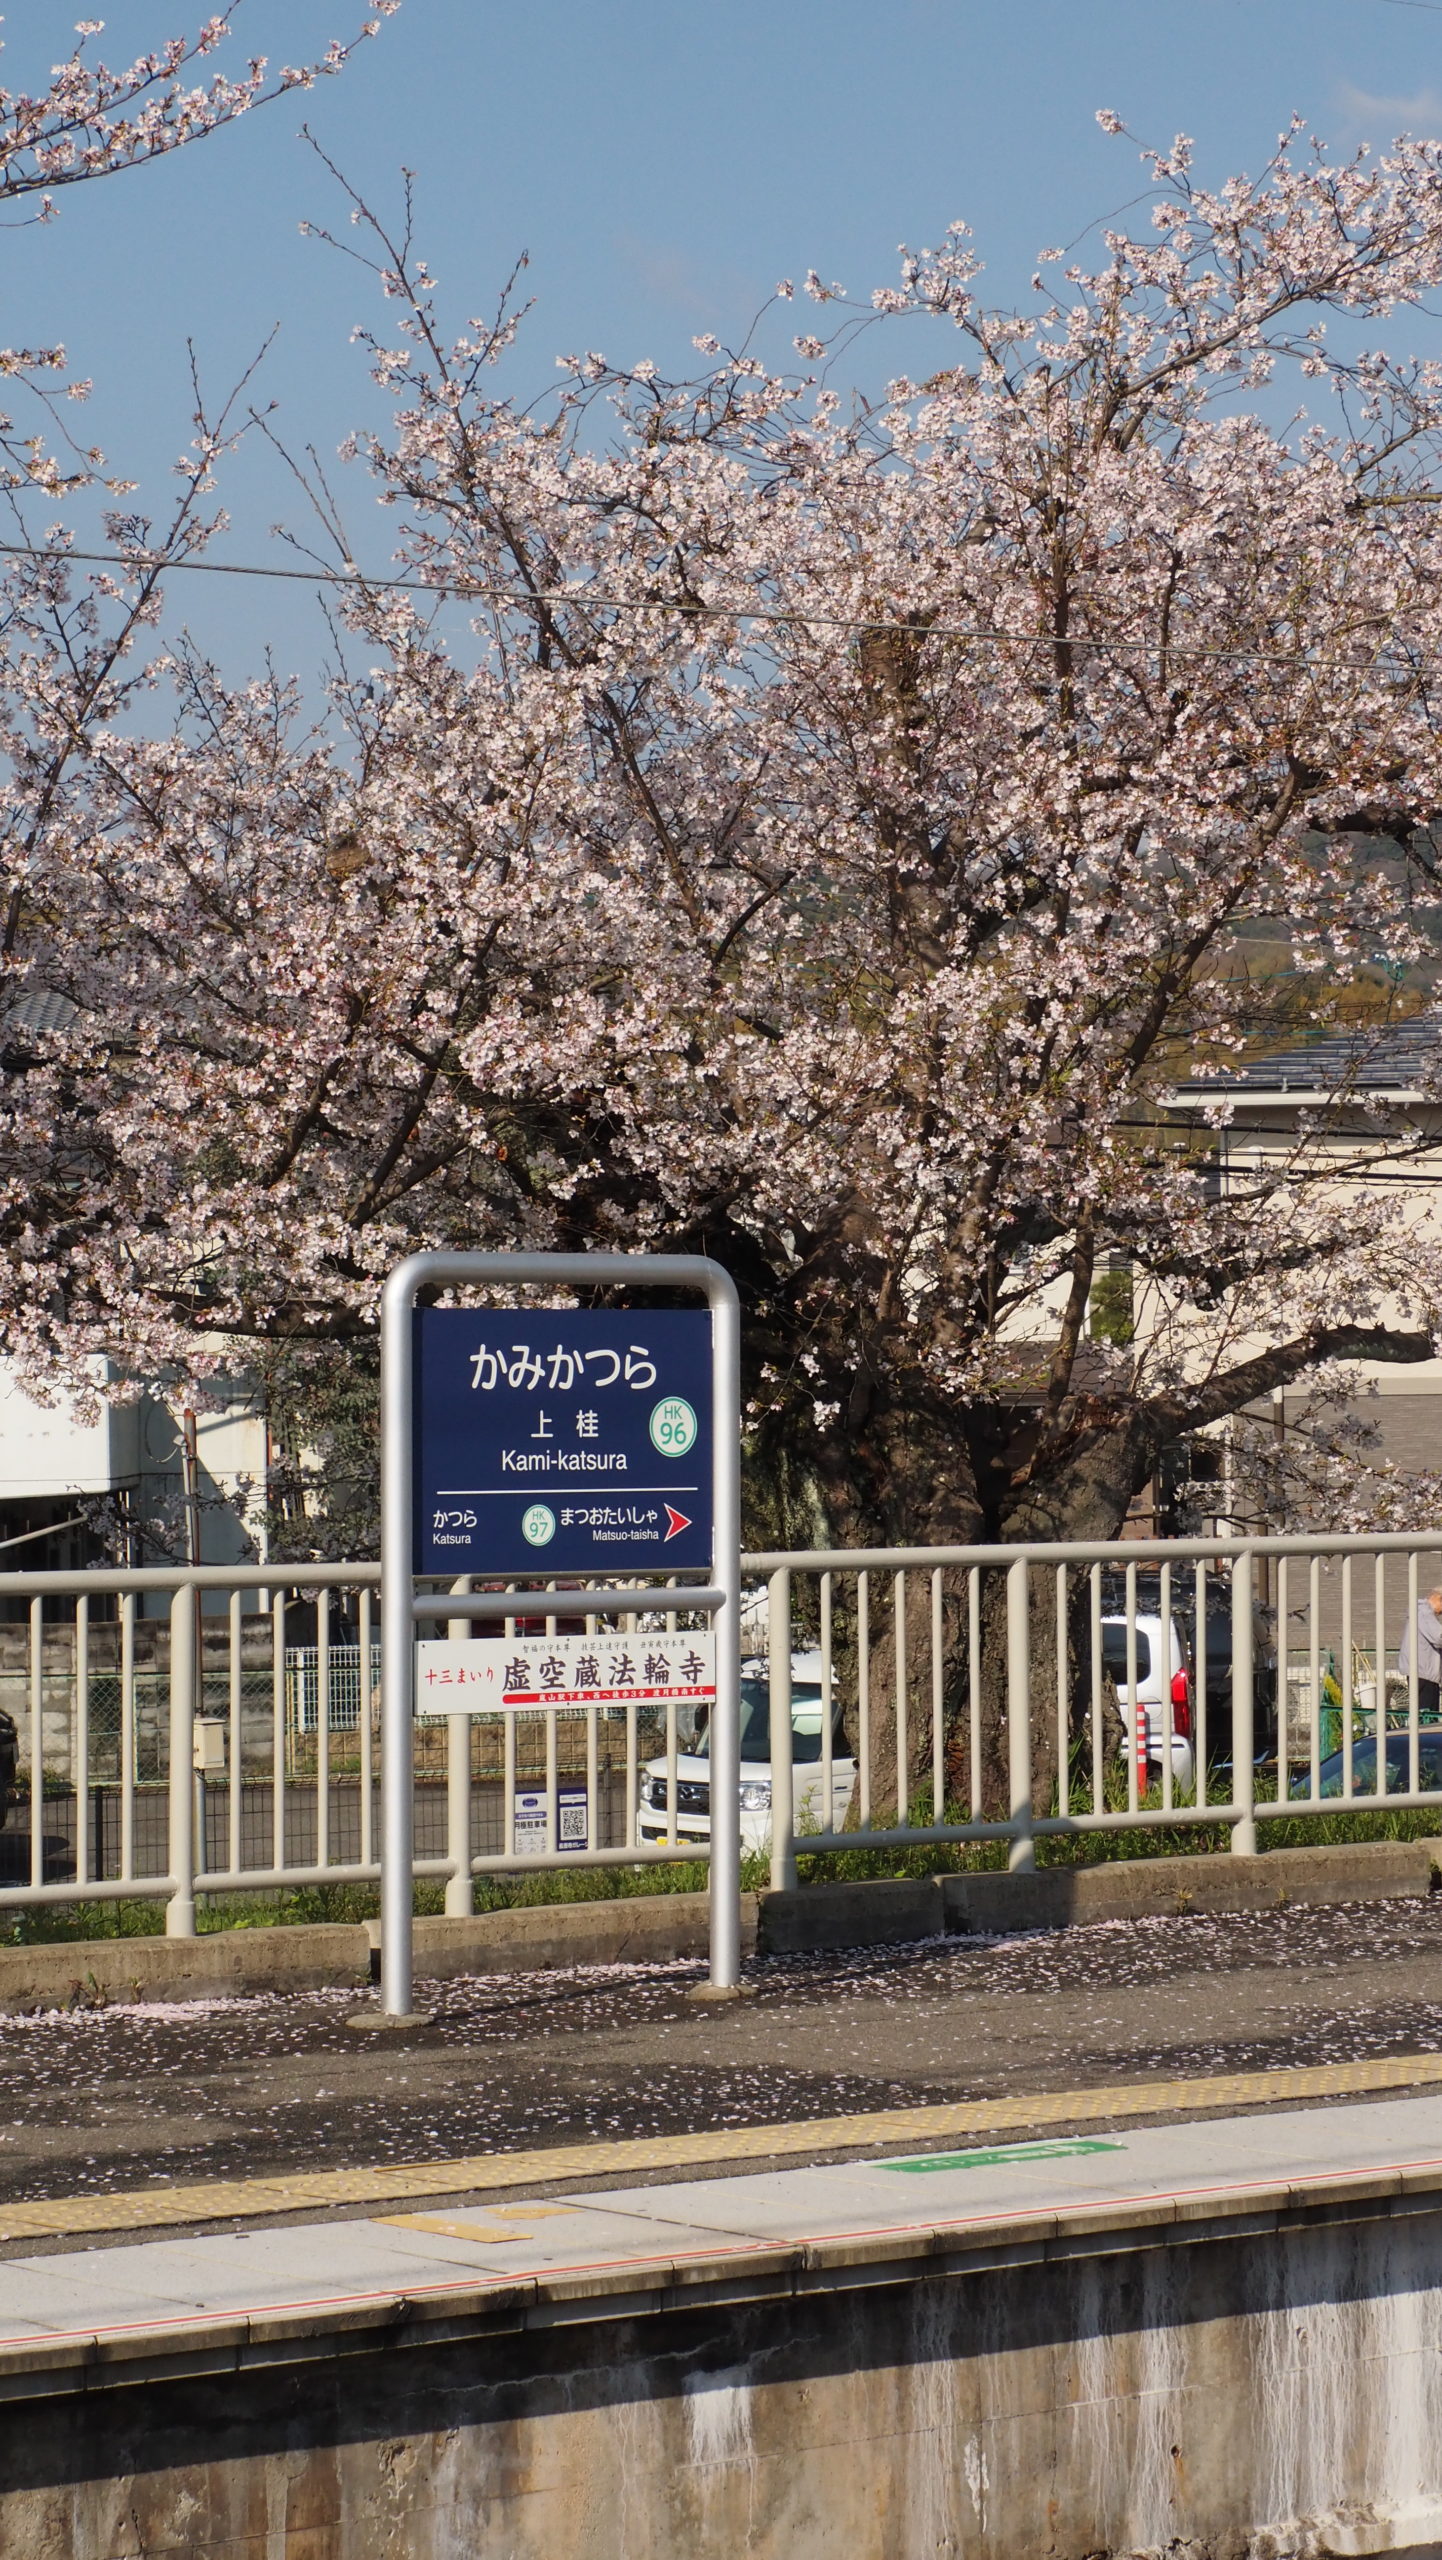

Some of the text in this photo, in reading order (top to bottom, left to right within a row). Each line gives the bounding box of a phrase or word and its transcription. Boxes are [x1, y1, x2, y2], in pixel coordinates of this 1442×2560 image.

[469, 1343, 657, 1390] かみかつら
[664, 1405, 683, 1420] HK
[660, 1422, 687, 1445] 96
[502, 1449, 628, 1471] Kami-katsura
[432, 1509, 478, 1528] かつら
[532, 1511, 546, 1521] HK
[560, 1506, 658, 1526] まつおたいしゃ
[432, 1533, 472, 1545] Katsura
[529, 1521, 548, 1538] 97
[592, 1529, 659, 1542] Matsuo-taisha
[424, 1666, 494, 1686] 十三まいり
[502, 1650, 706, 1692] 虚空蔵法輪寺
